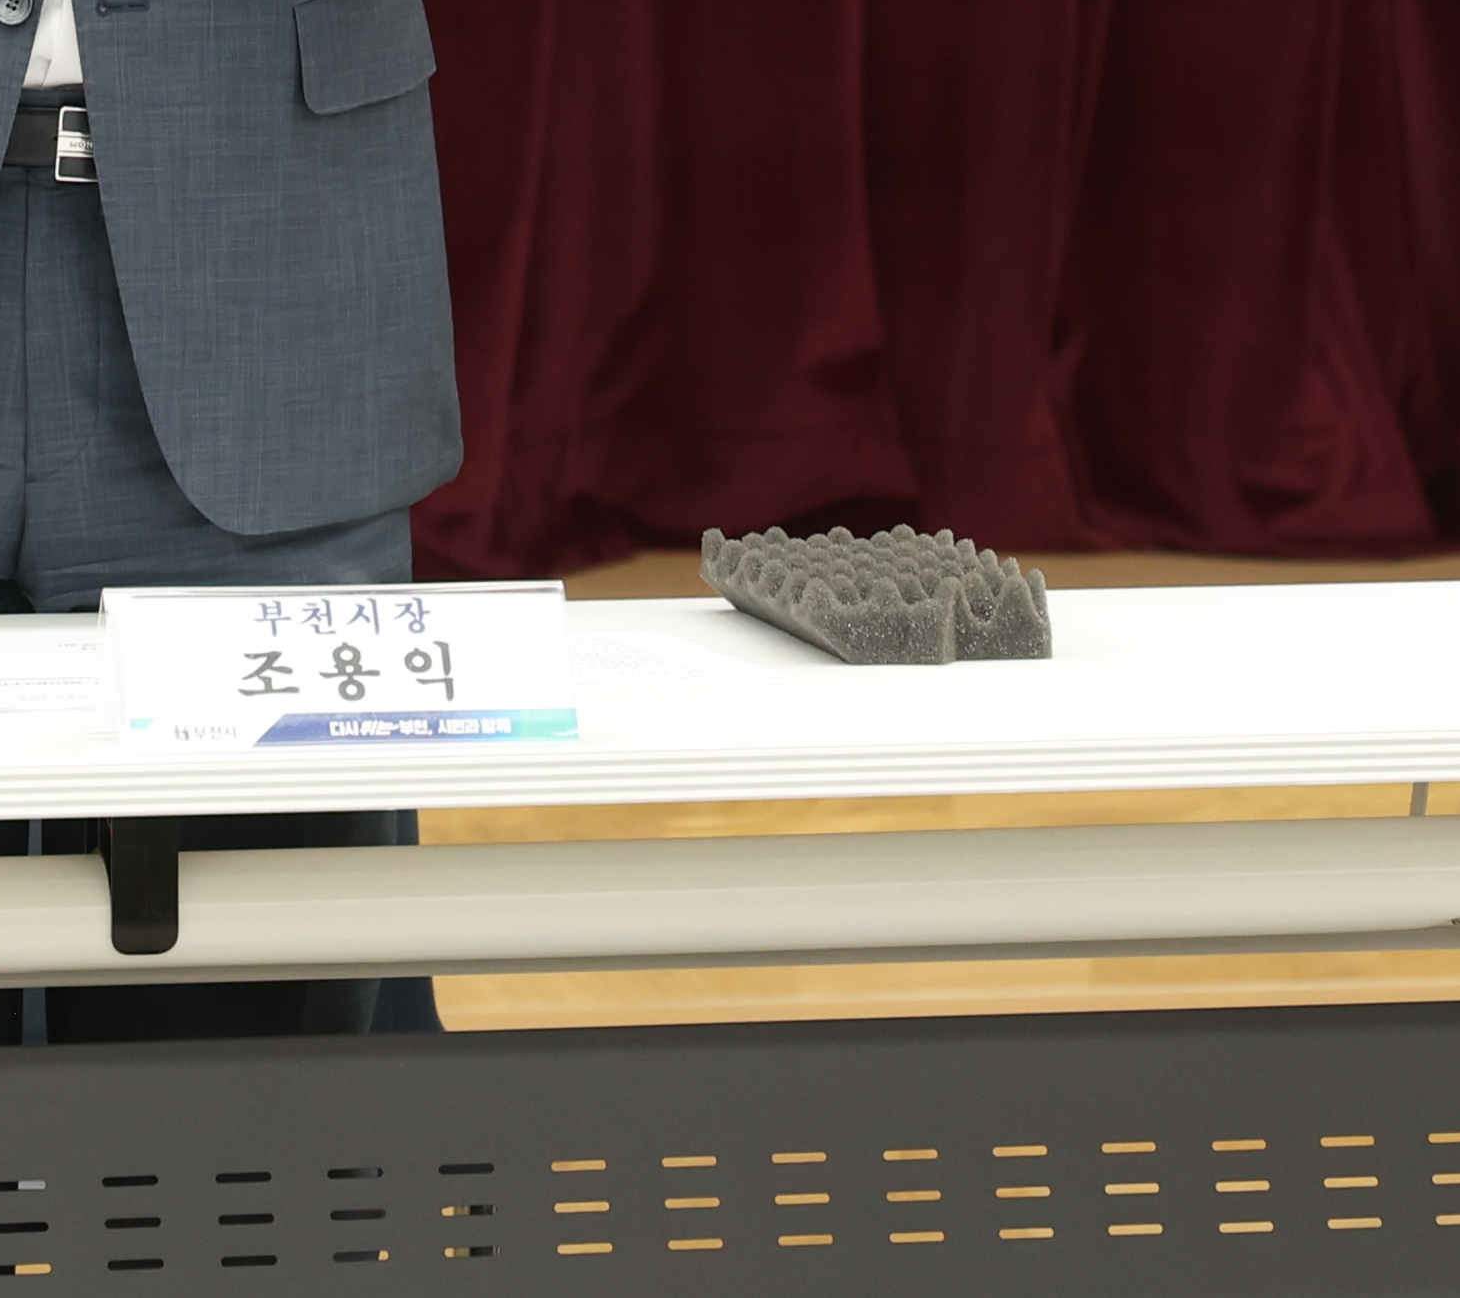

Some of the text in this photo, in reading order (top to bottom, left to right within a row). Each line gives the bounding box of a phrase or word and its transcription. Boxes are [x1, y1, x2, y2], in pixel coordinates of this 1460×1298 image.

[253, 597, 431, 637] 부천시장
[237, 641, 455, 702] 조용익
[193, 725, 237, 740] 부천시
[330, 721, 359, 737] 다시
[438, 718, 479, 735] 시민과
[480, 717, 513, 735] 함께
